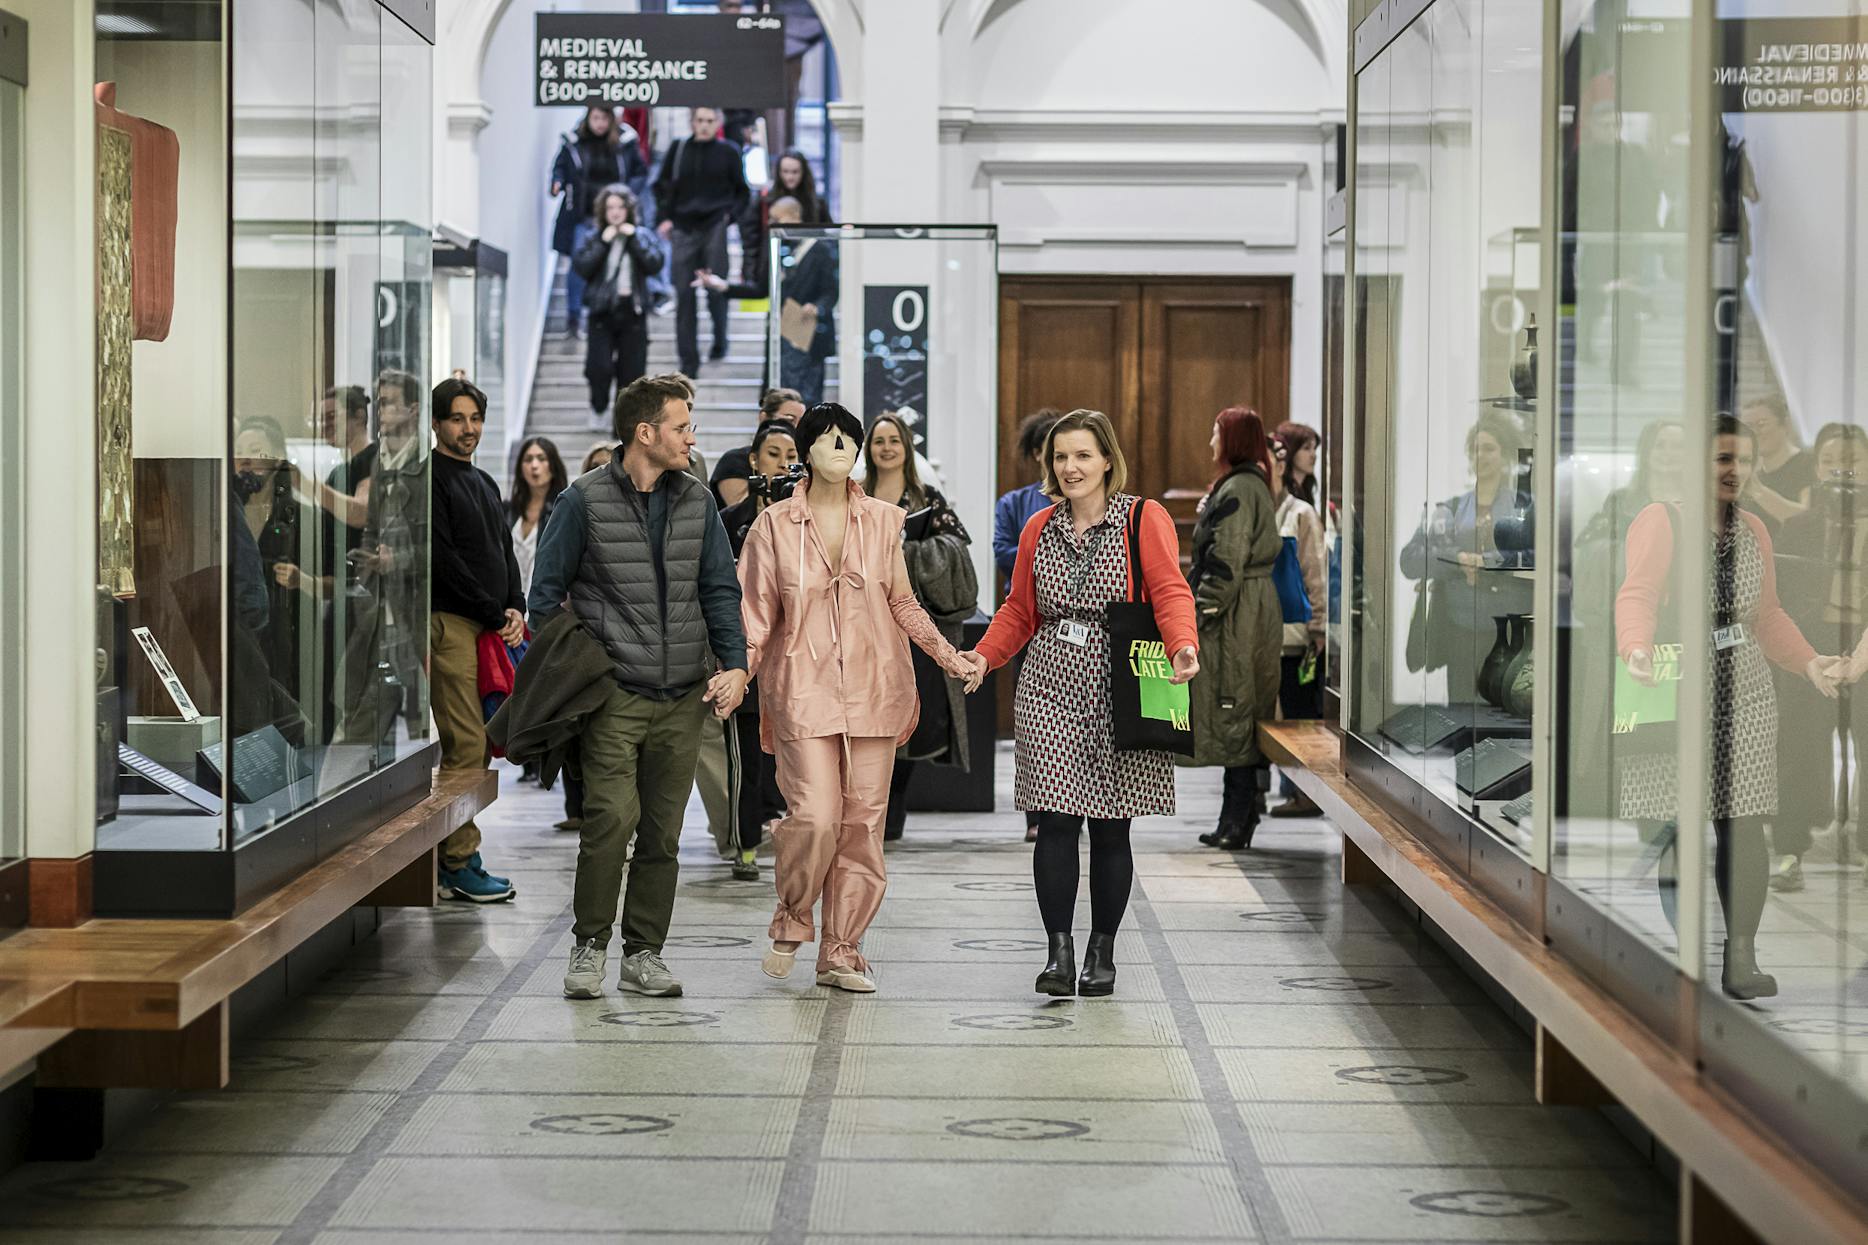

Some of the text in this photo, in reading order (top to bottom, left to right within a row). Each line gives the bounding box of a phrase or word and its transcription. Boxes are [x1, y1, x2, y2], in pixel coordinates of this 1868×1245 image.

[540, 38, 648, 58] MEDIEVAL
[540, 60, 708, 80] & RENAISSANCE
[540, 81, 659, 104] (300–1600)
[892, 290, 925, 332] 0
[1129, 640, 1167, 659] FRID
[1129, 659, 1169, 679] LATE
